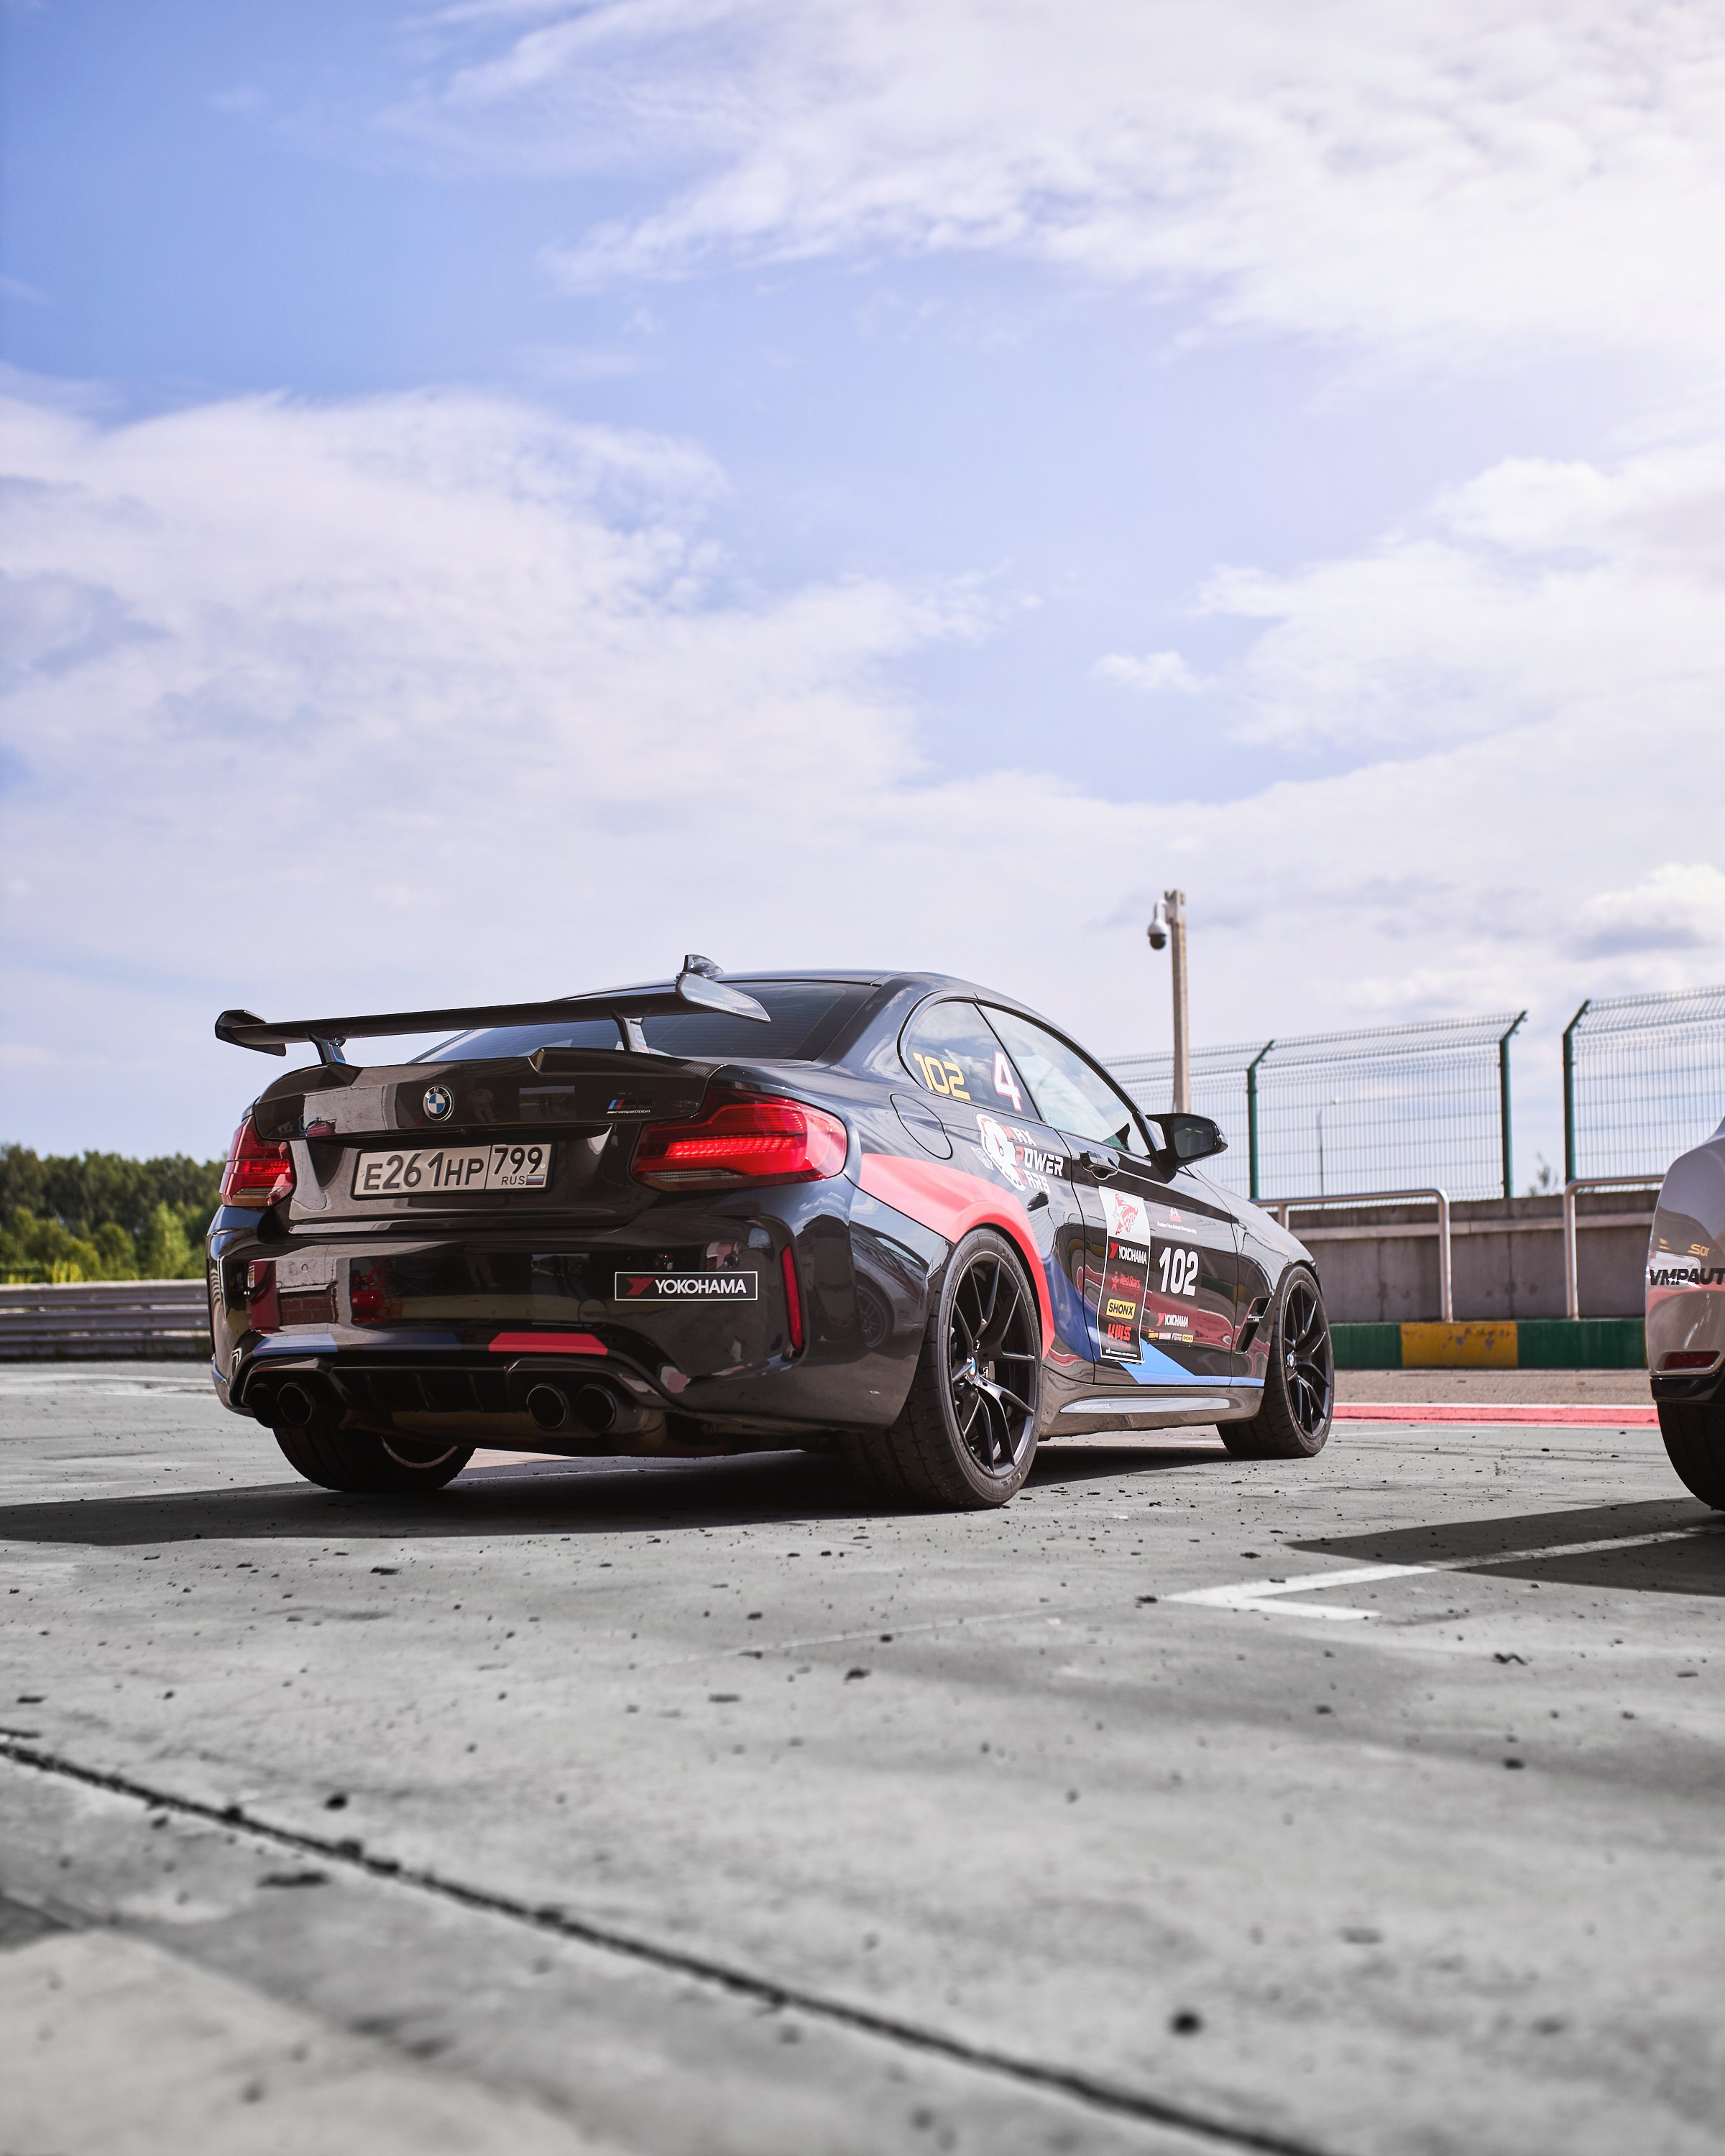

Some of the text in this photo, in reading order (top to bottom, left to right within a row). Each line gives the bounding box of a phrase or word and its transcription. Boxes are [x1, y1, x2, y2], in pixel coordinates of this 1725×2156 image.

[913, 1052, 971, 1100] 102
[993, 1051, 1022, 1112] 4
[426, 1087, 448, 1099] BMW
[493, 1147, 543, 1175] 799
[1015, 1146, 1064, 1176] POWER
[501, 1175, 525, 1185] RUS
[1015, 1167, 1051, 1194] CARS
[1118, 1245, 1148, 1266] YOKOHAMA
[1119, 1273, 1141, 1289] Red Stars
[1159, 1246, 1199, 1296] 102
[655, 1279, 747, 1294] YOKOHAMA
[1108, 1302, 1133, 1317] SHONX
[1164, 1314, 1189, 1328] YOKOHAMA
